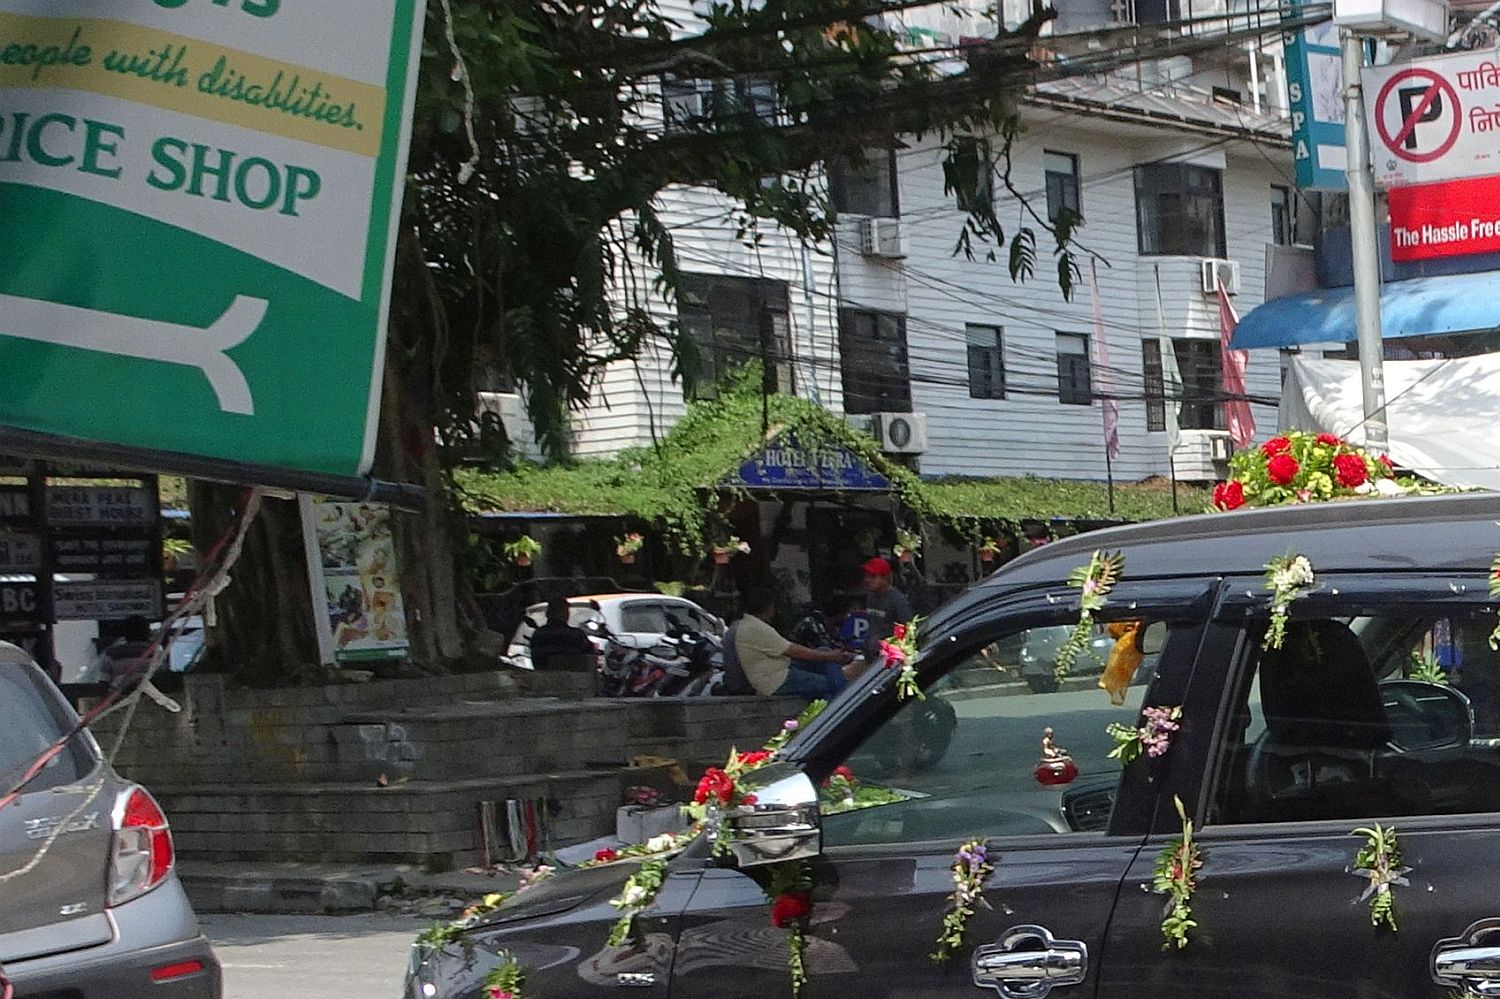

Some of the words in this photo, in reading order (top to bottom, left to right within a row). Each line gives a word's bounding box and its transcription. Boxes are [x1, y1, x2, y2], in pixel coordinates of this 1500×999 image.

[1, 25, 92, 80] eople
[103, 44, 187, 86] with
[0, 111, 125, 179] ICE
[146, 136, 322, 217] SHOP
[1394, 227, 1420, 247] The
[1422, 220, 1469, 244] Hassle
